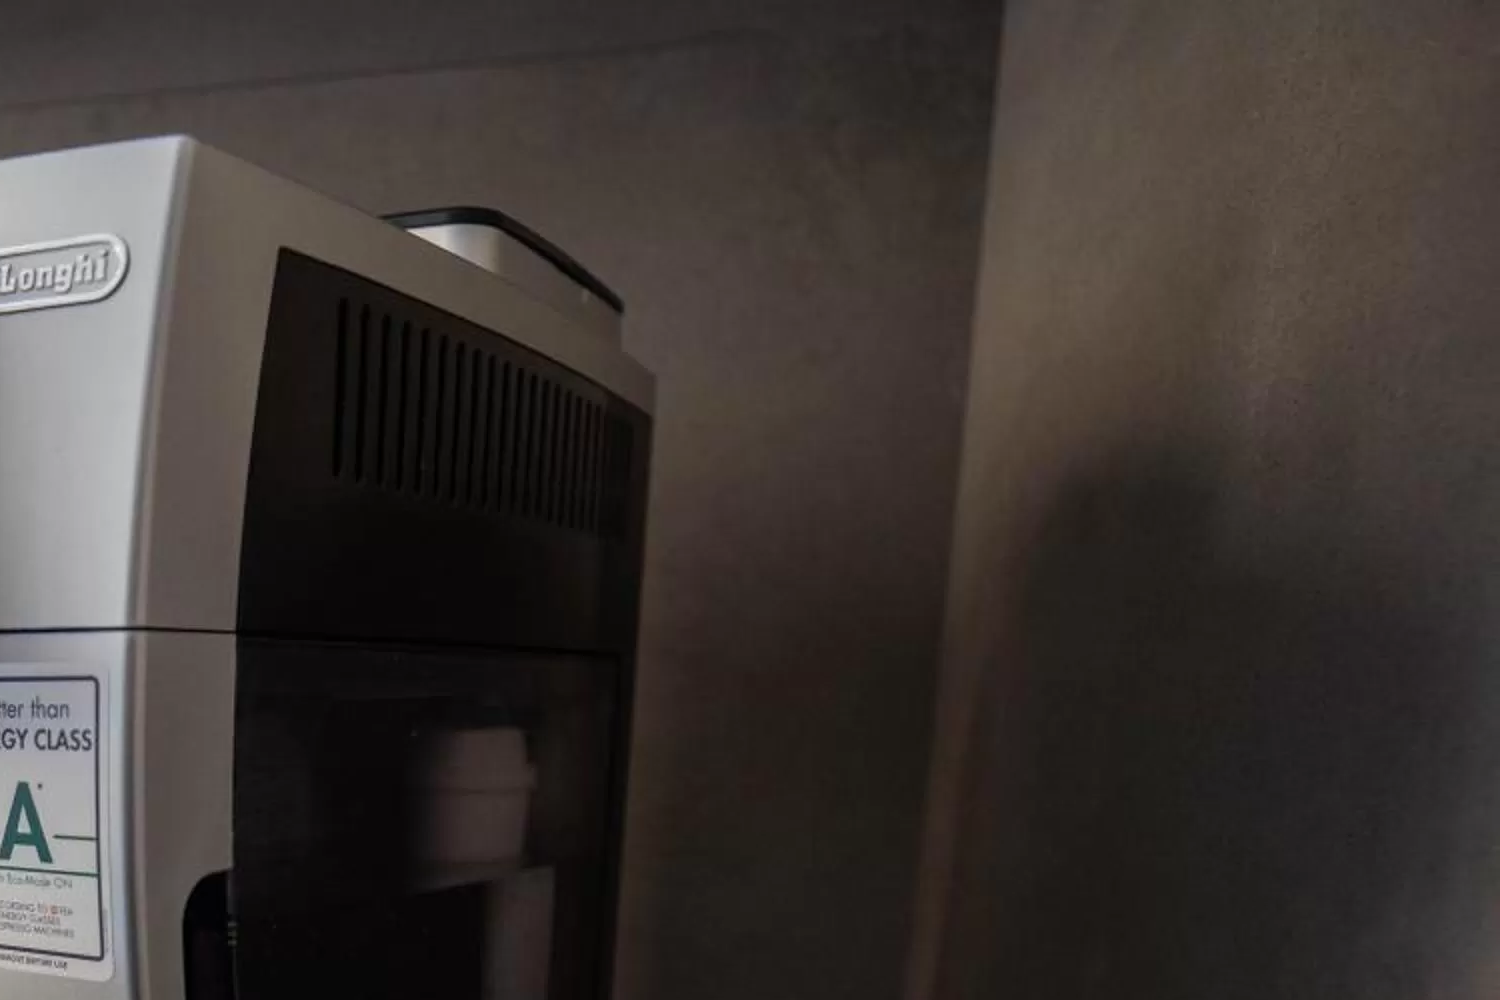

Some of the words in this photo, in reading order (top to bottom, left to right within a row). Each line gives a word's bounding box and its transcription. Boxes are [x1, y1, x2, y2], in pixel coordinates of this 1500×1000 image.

[31, 696, 69, 719] than
[34, 728, 92, 751] CLASS
[53, 877, 73, 889] ON
